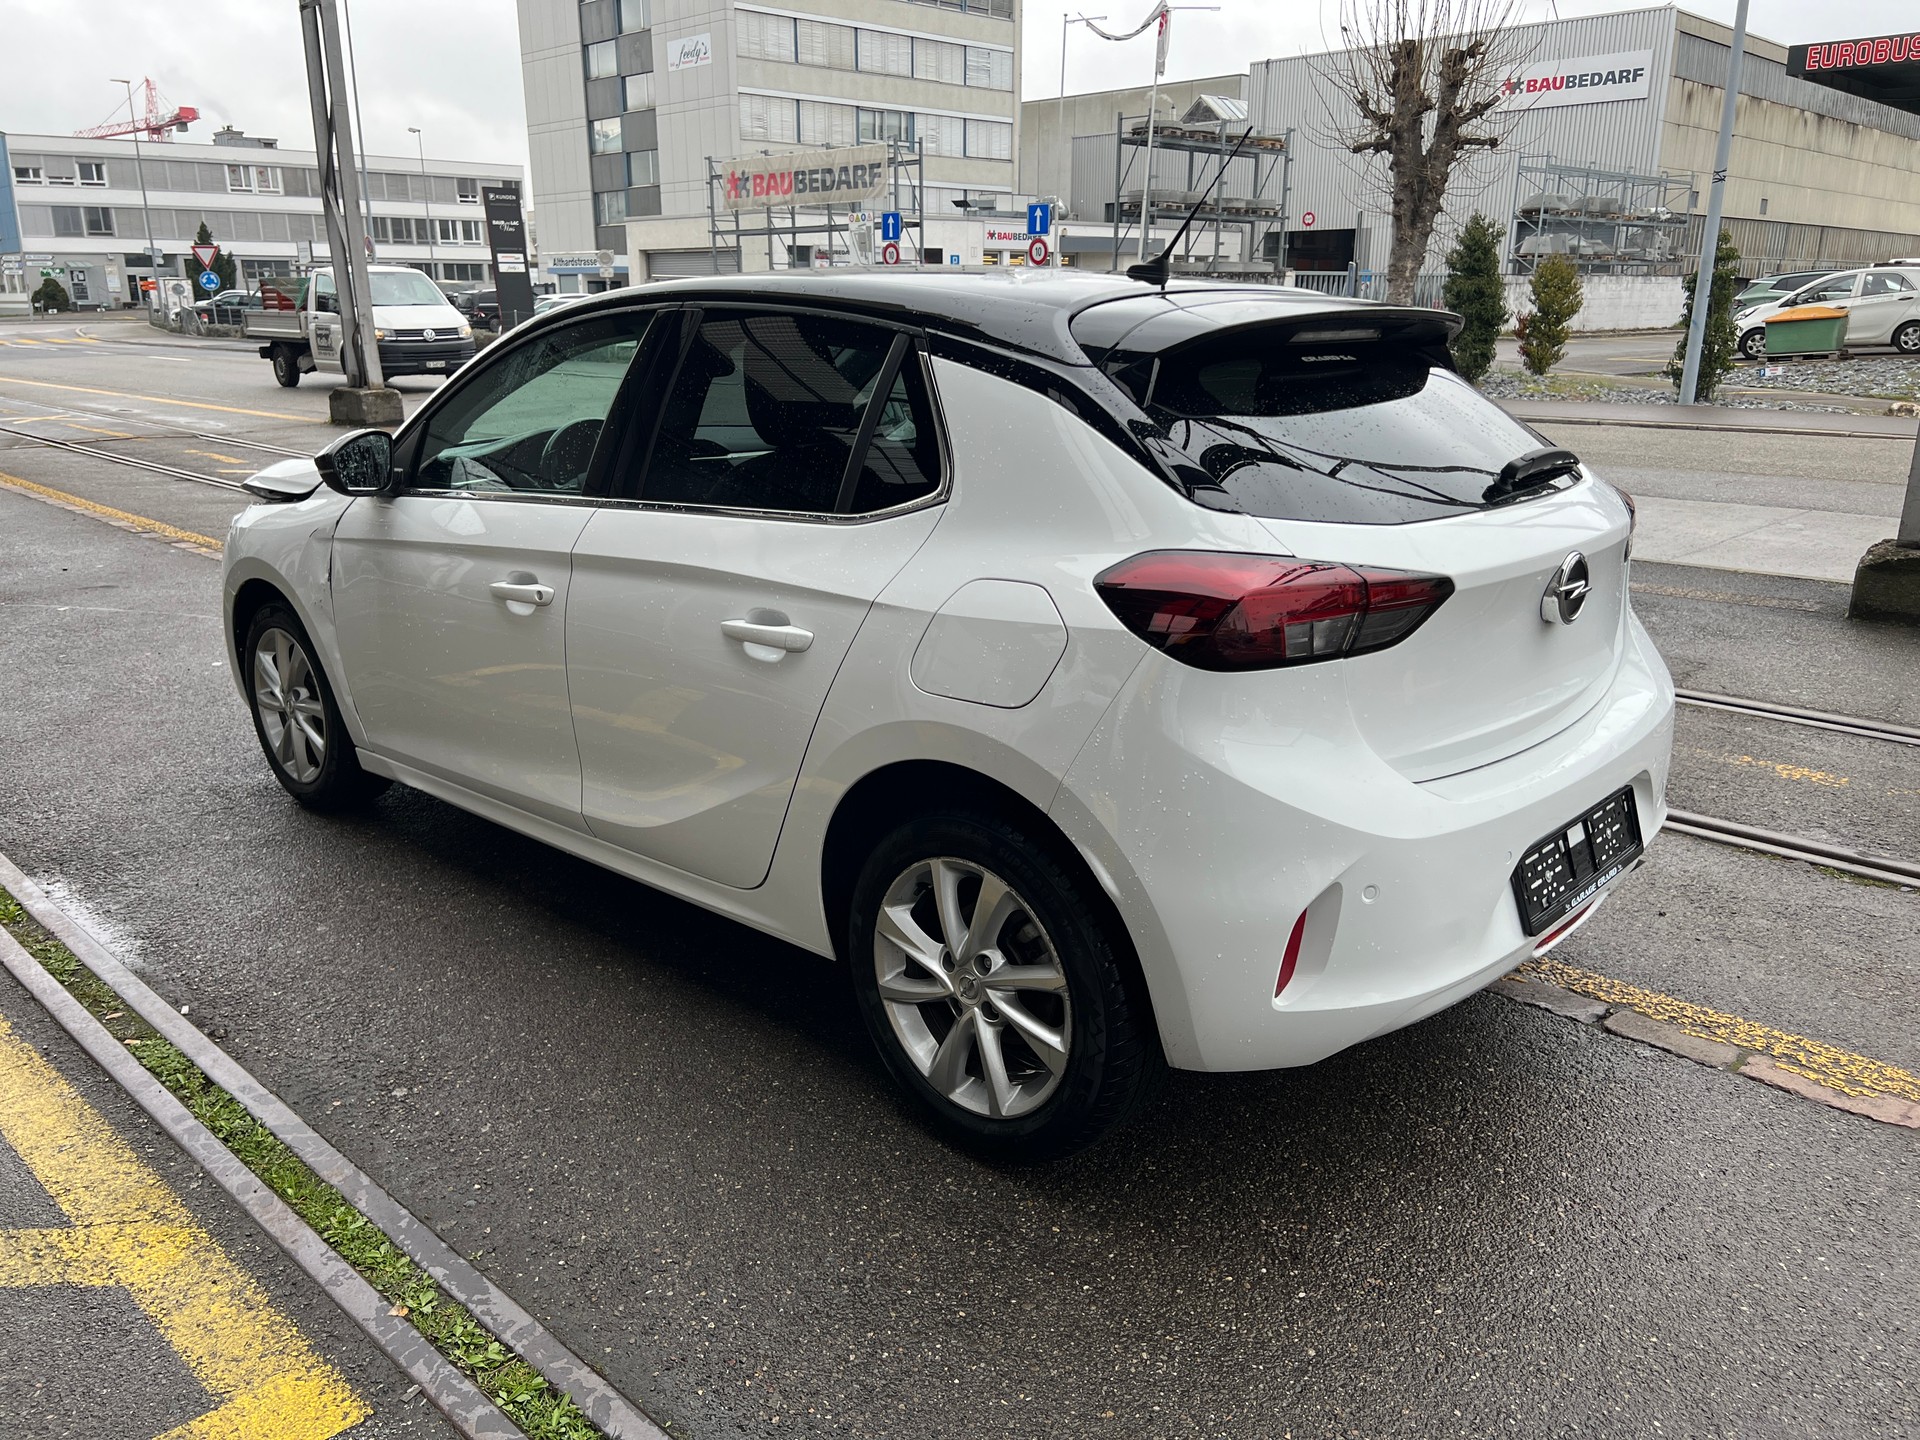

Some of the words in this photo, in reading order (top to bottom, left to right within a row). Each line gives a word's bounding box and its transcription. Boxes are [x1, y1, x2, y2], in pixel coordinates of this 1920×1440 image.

[1805, 35, 1920, 70] EUROBUS
[1526, 67, 1645, 93] BAUBEDARF
[752, 162, 882, 197] BAUBEDARF
[997, 232, 1041, 240] BAUBEDA
[888, 250, 895, 260] 10
[1035, 247, 1042, 256] 10
[553, 257, 598, 266] Althardstrasse
[1571, 882, 1597, 907] GARAGE
[1597, 867, 1618, 887] ERARD
